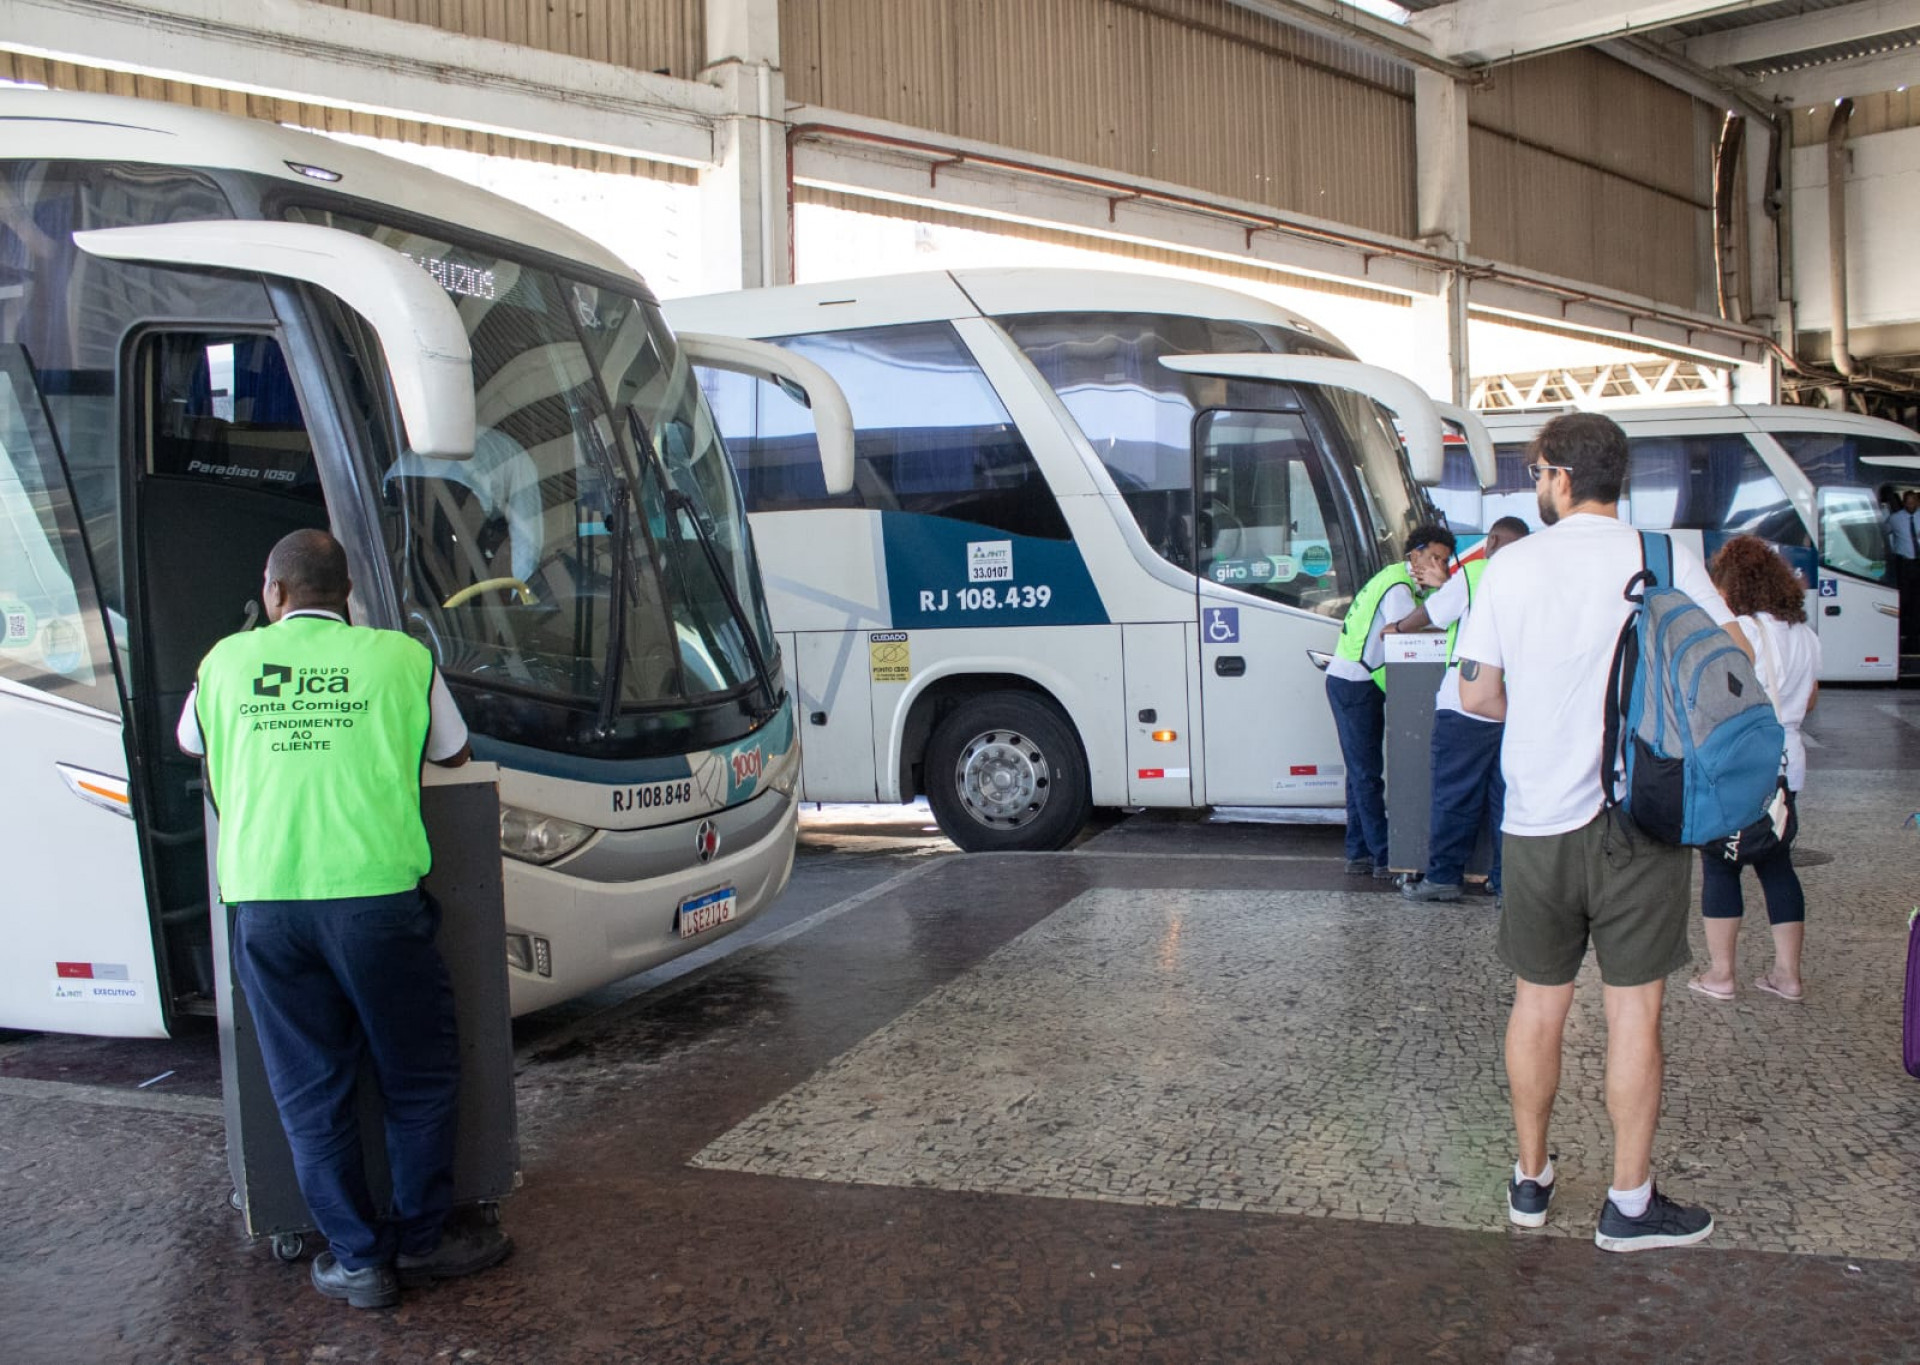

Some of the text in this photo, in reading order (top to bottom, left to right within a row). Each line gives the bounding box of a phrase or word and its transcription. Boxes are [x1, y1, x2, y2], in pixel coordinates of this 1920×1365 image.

[430, 258, 494, 299] BUZIOS
[187, 460, 296, 481] Paradiso 1050
[973, 566, 1008, 579] 33.0107
[1216, 565, 1248, 583] giro
[919, 585, 1052, 612] RJ 108.439
[299, 667, 349, 675] GRUPO
[295, 675, 349, 695] jca
[240, 699, 369, 715] Conta Comigo!
[253, 718, 354, 732] ATENDIMENTO
[291, 730, 312, 740] AO
[271, 740, 331, 752] CLIENTE
[732, 747, 762, 788] 1001
[613, 782, 691, 812] RJ 108.848
[93, 988, 137, 997] EXECUTIVO
